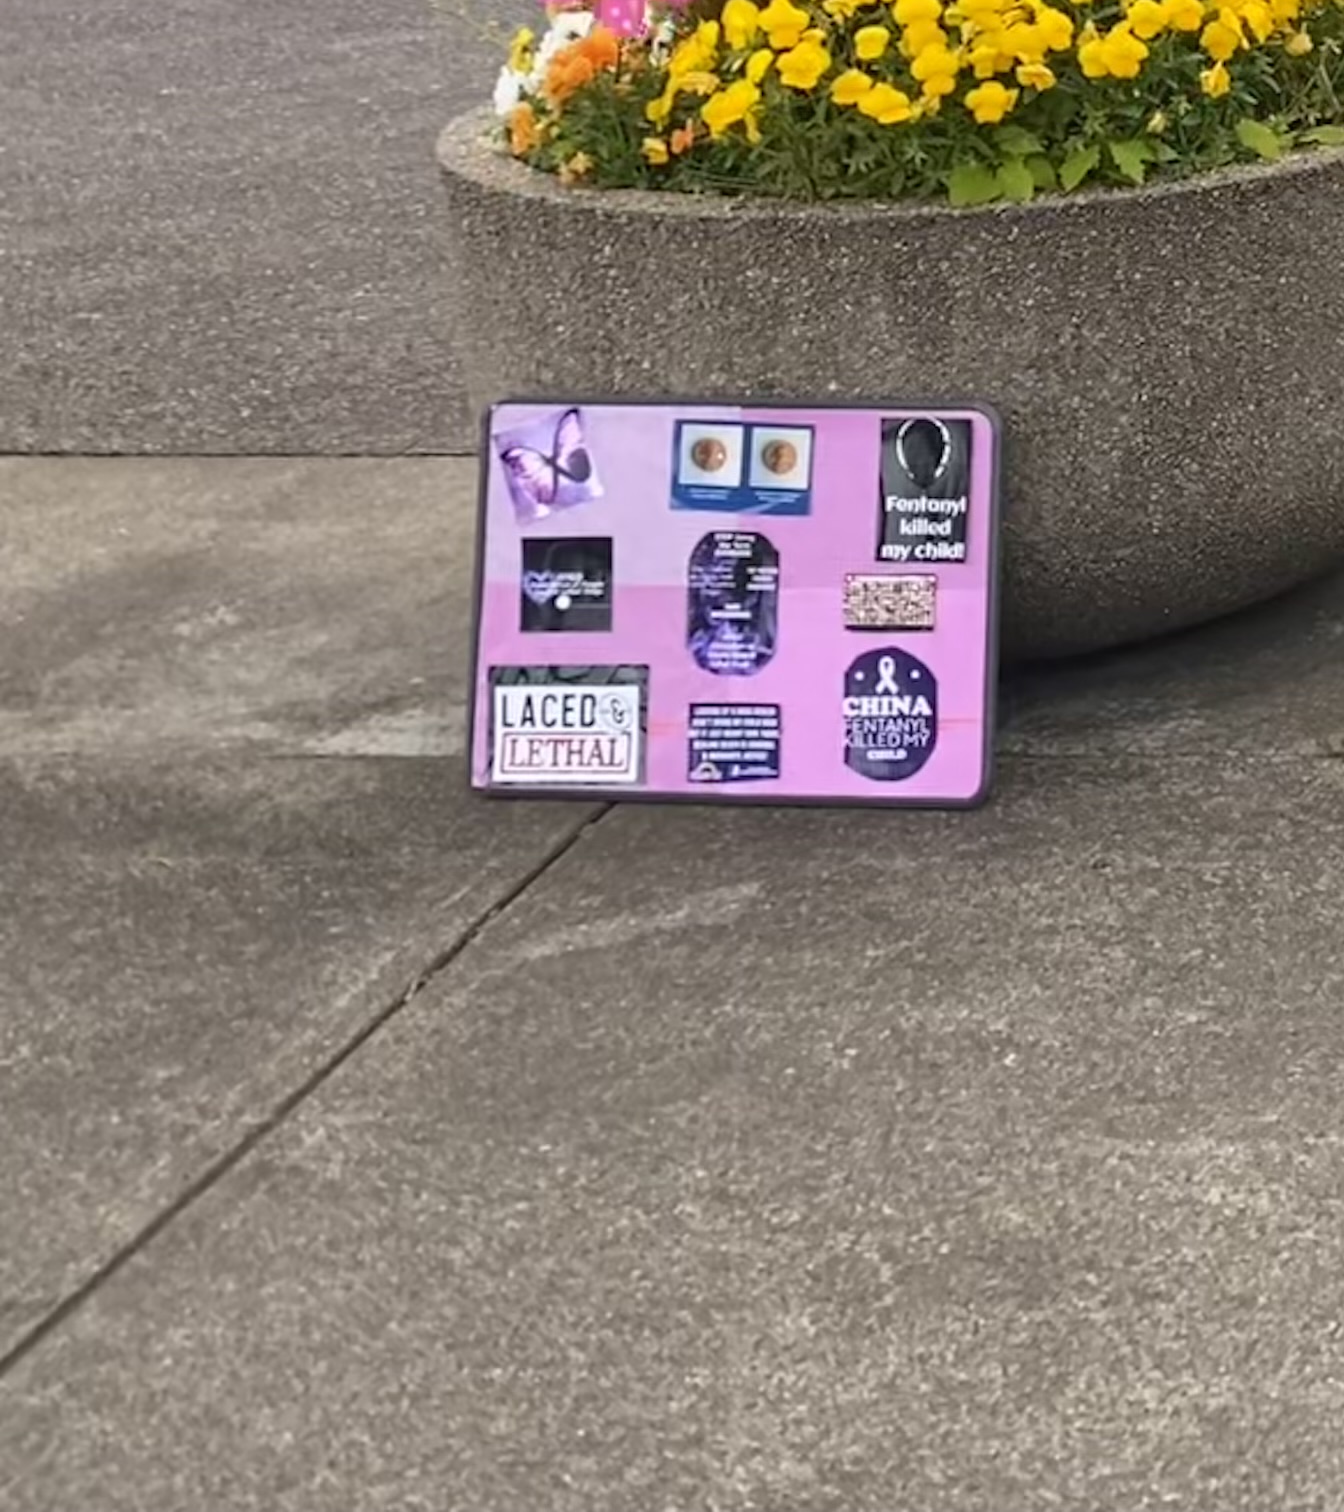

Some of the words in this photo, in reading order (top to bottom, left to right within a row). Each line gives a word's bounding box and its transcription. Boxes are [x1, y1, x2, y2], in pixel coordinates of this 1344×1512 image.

[886, 496, 967, 517] Fentanyl
[900, 518, 951, 535] killed
[881, 544, 912, 561] my
[914, 542, 965, 560] child!
[502, 694, 597, 727] LACED
[610, 698, 626, 724] &
[842, 695, 933, 717] CHINA
[903, 730, 930, 747] MY
[508, 738, 624, 767] LETHAL
